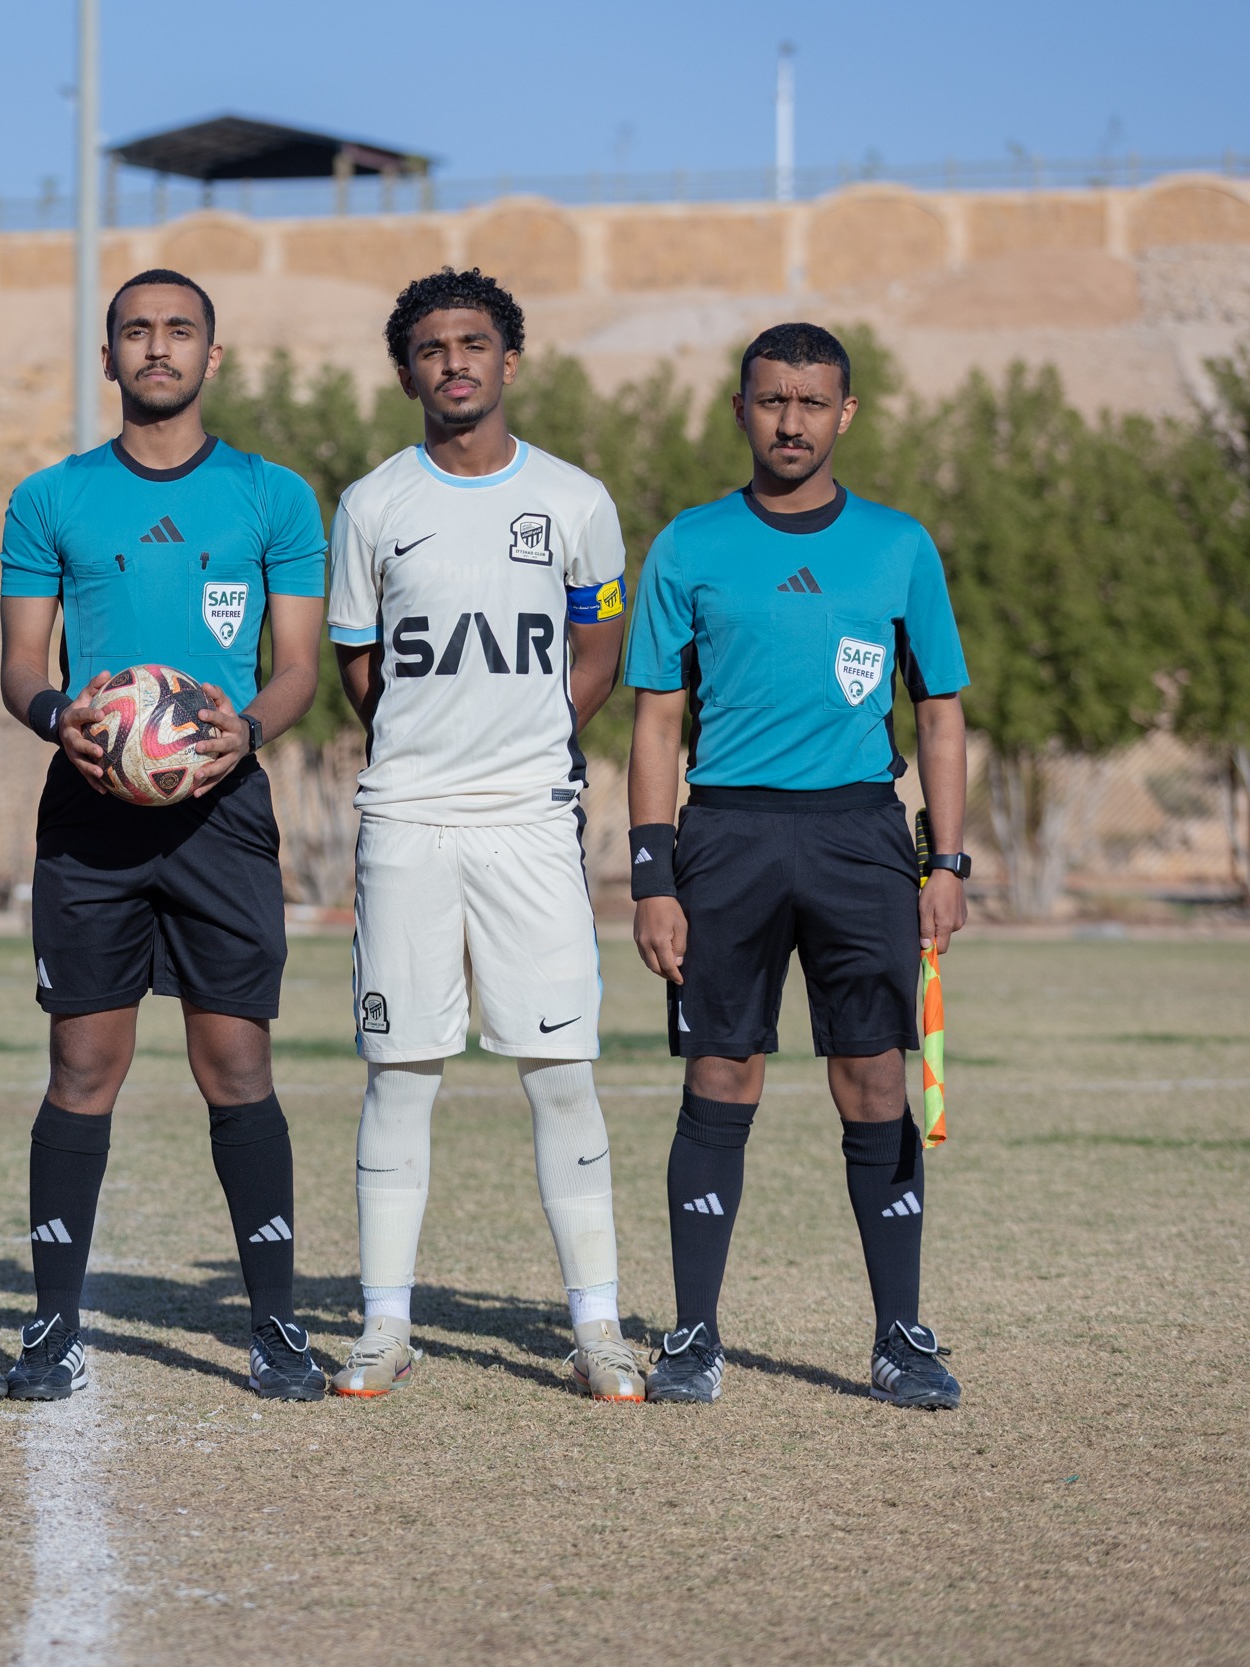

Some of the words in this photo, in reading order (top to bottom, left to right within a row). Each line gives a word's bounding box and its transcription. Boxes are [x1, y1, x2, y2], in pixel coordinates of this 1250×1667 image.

[208, 591, 245, 606] SAFF
[211, 610, 241, 618] REFEREE
[392, 612, 555, 678] SAR
[842, 646, 881, 667] SAFF
[843, 666, 874, 679] REFEREE
